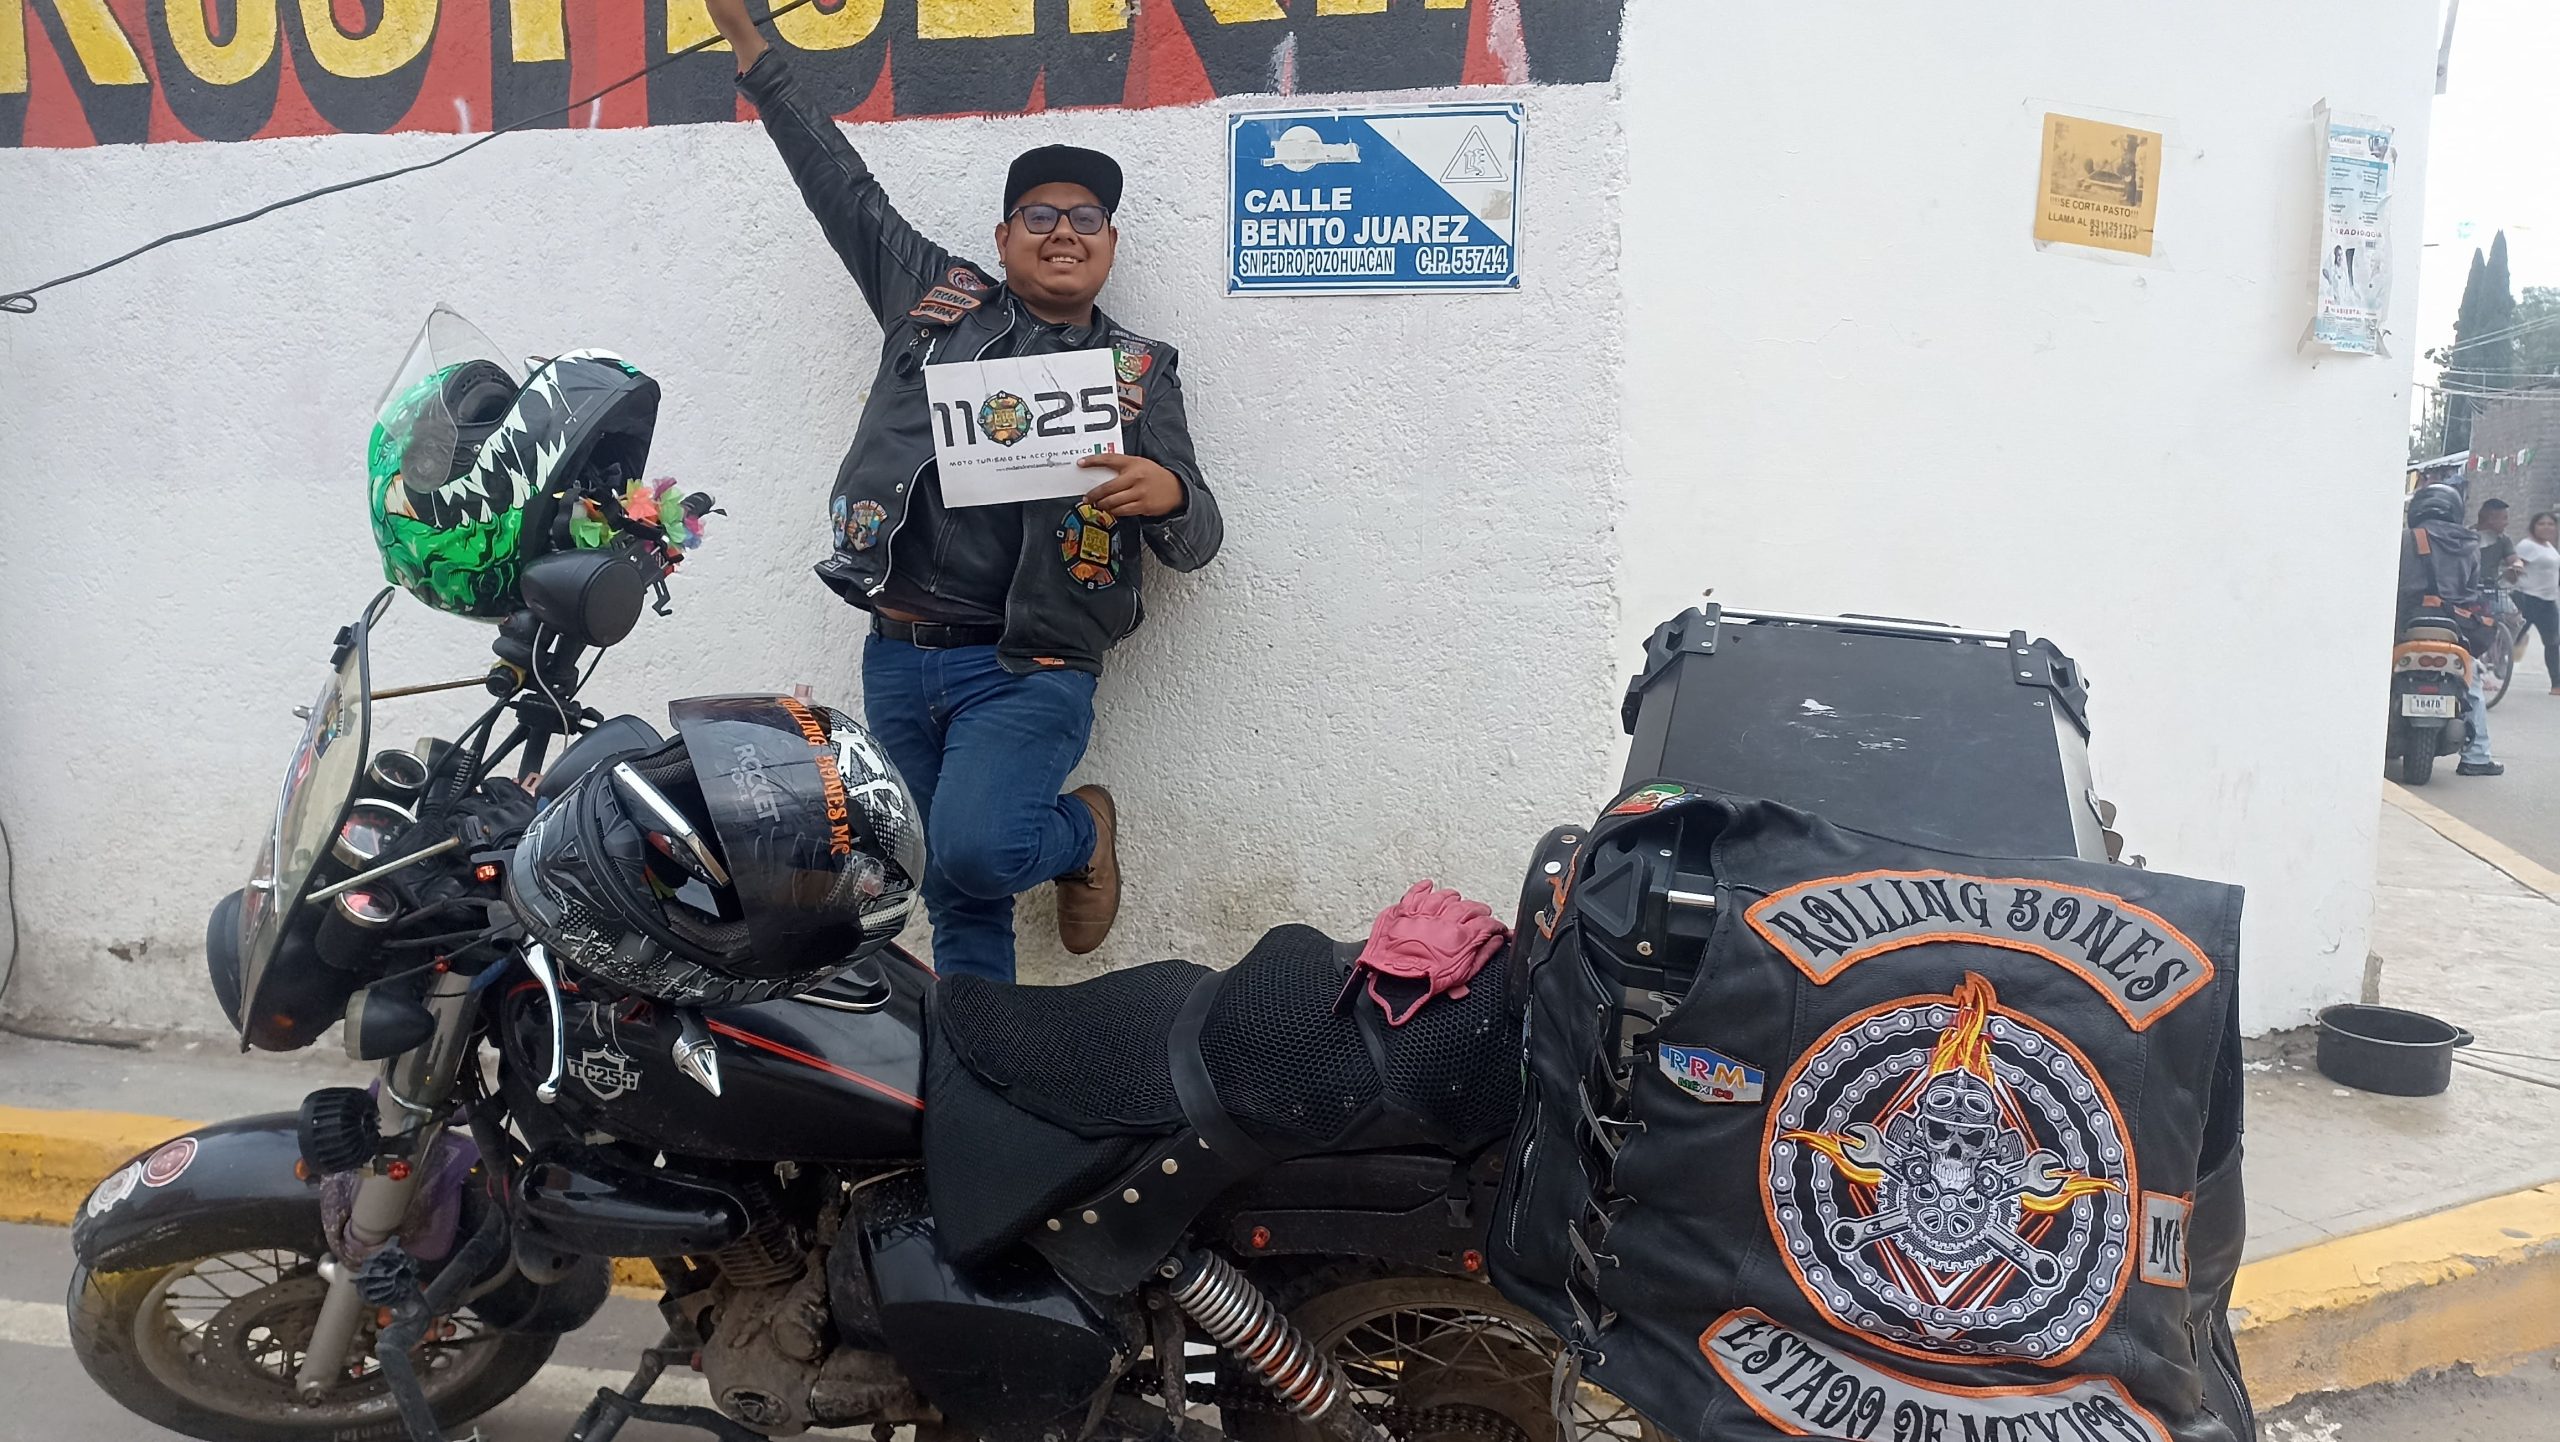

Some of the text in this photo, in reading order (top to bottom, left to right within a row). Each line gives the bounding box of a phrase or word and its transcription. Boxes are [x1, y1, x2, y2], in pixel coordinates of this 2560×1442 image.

[1244, 187, 1352, 213] CALLE
[2072, 200, 2101, 212] CORTA
[1241, 215, 1469, 247] BENITO JUAREZ
[2048, 212, 2076, 223] LLAMA
[2077, 217, 2088, 227] AL
[1239, 248, 1259, 276] SN
[1260, 248, 1304, 276] PEDRO
[1306, 248, 1394, 276] POZOHUACAN
[1062, 448, 1093, 456] MEXICO
[730, 767, 750, 802] FORCE
[733, 743, 781, 822] ROCKET
[815, 754, 848, 821] BONES
[829, 823, 850, 855] MC
[1765, 878, 2191, 1003] ROLLING BONES
[1668, 1047, 1746, 1089] RRM
[1719, 1320, 1887, 1440] ESTADO
